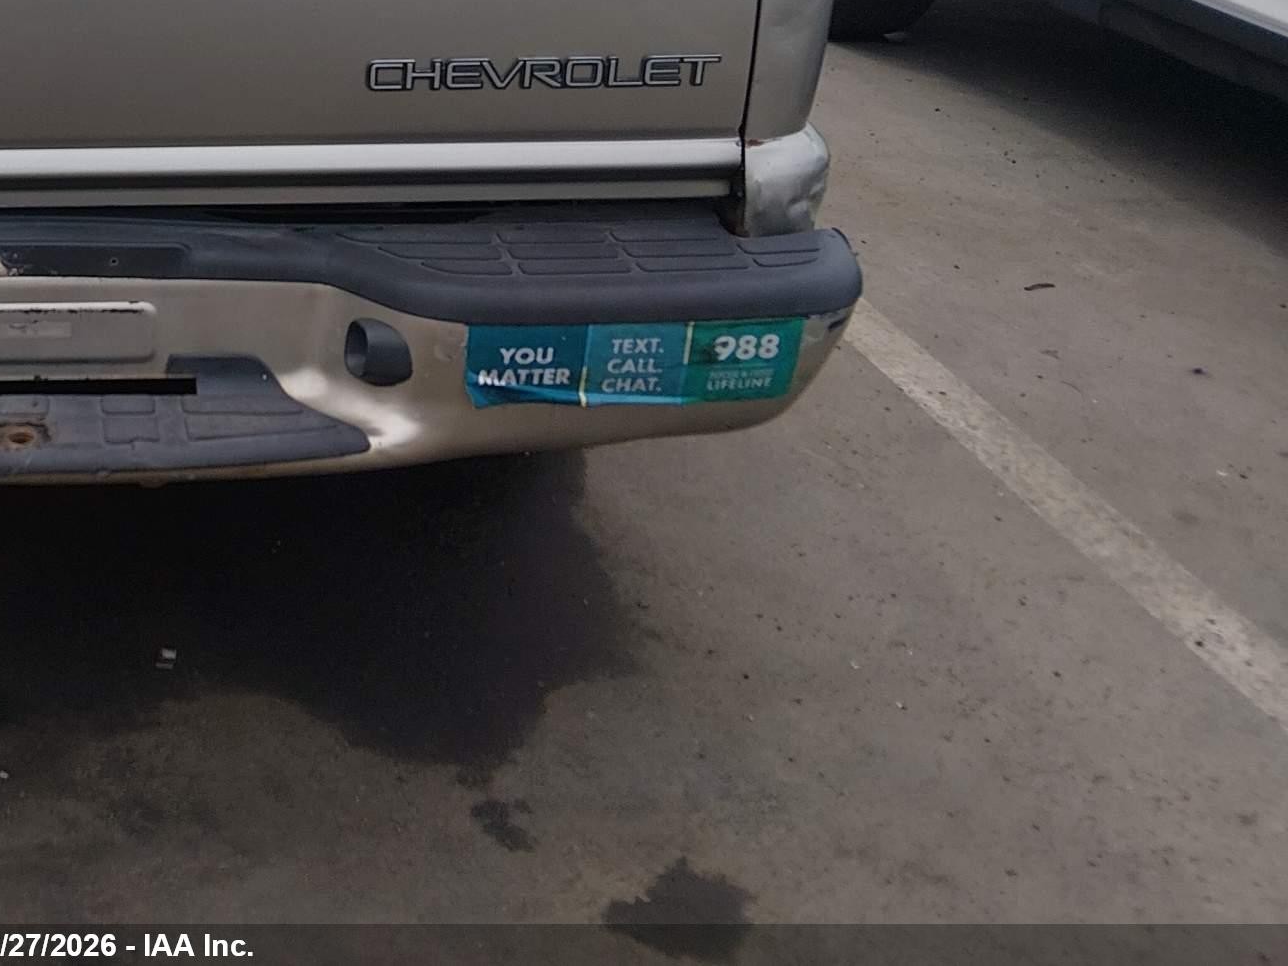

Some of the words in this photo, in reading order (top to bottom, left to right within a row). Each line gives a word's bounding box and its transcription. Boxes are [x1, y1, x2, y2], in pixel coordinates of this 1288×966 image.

[367, 54, 722, 91] CHEVROLET
[499, 346, 555, 366] YOU
[611, 337, 665, 355] TEXT.
[713, 333, 780, 362] 988
[607, 358, 664, 374] CALL.
[477, 367, 571, 387] MATTER
[601, 377, 662, 393] CHAT.
